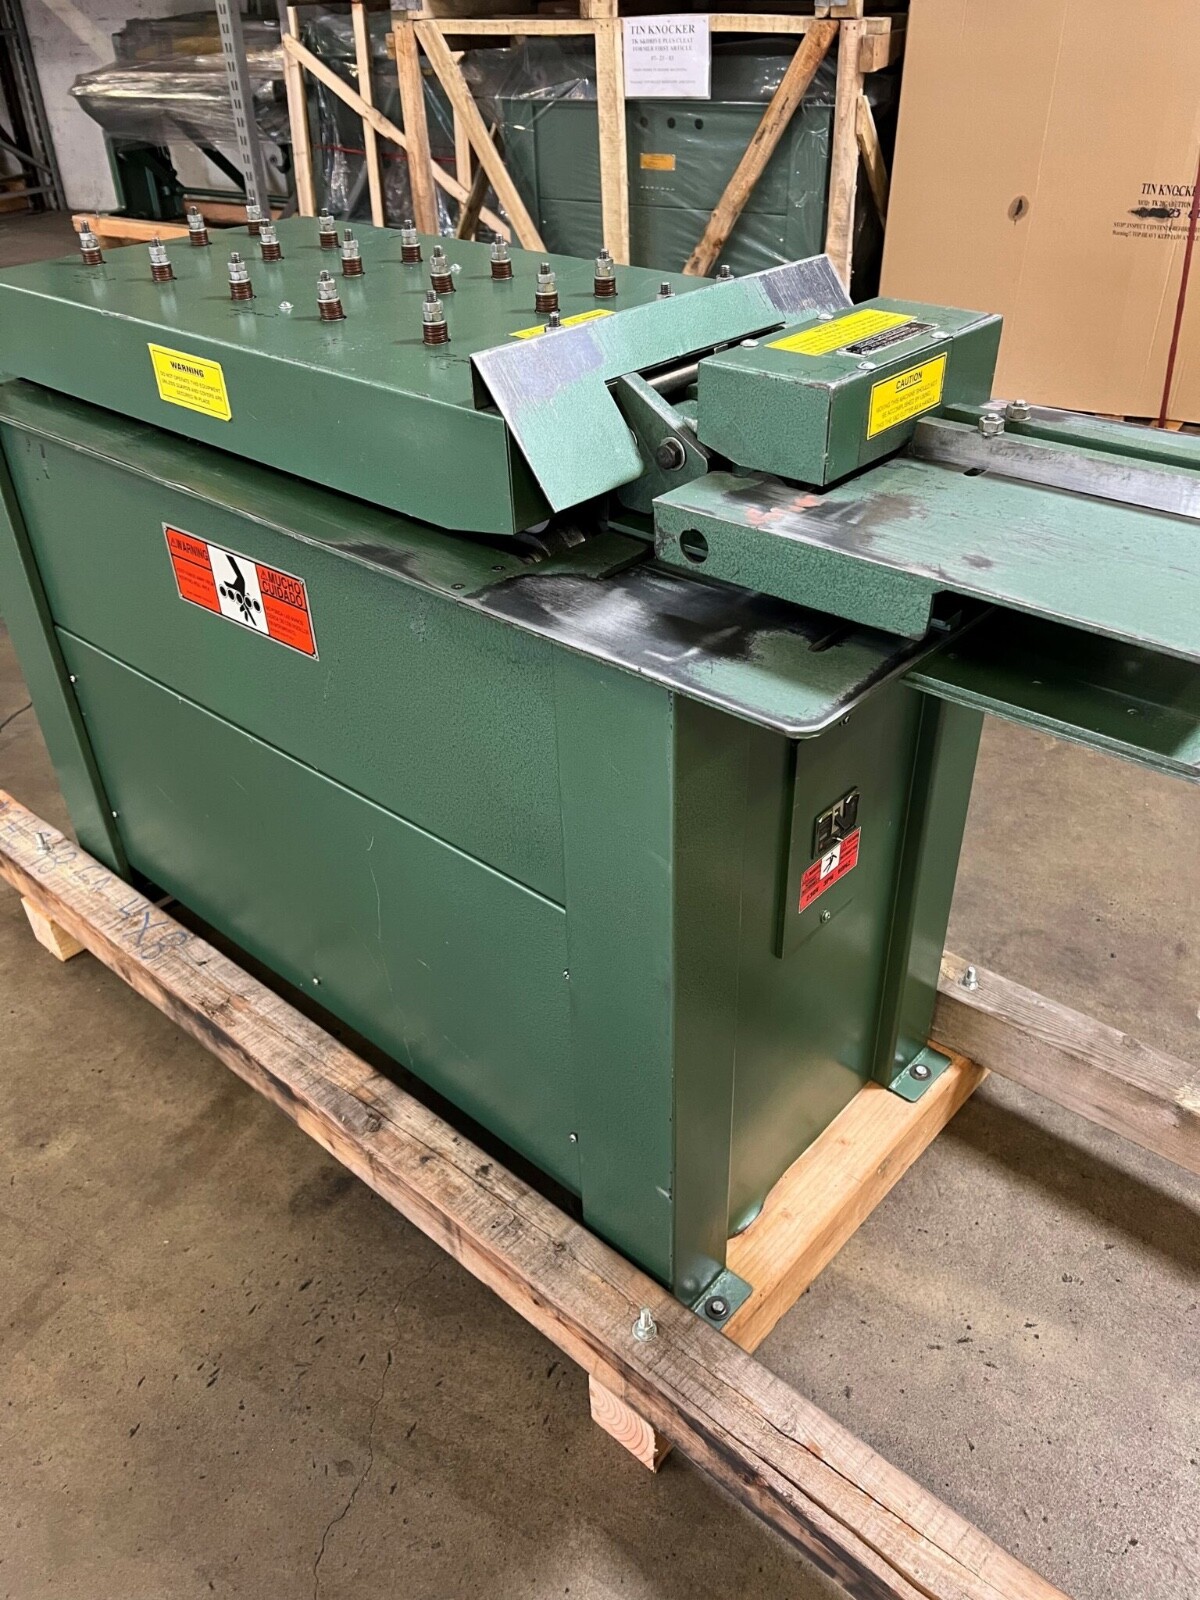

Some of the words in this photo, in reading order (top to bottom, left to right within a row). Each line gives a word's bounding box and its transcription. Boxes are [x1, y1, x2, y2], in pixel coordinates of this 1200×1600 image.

[631, 25, 646, 35] TIN
[648, 24, 695, 34] KNOCKER
[1142, 183, 1157, 195] TIN
[1159, 184, 1197, 197] KNOCK
[169, 360, 204, 377] WARNING
[896, 371, 922, 389] CAUTION
[175, 539, 209, 561] WARNING
[267, 572, 301, 594] MUCHO
[261, 581, 303, 607] CUIDADO
